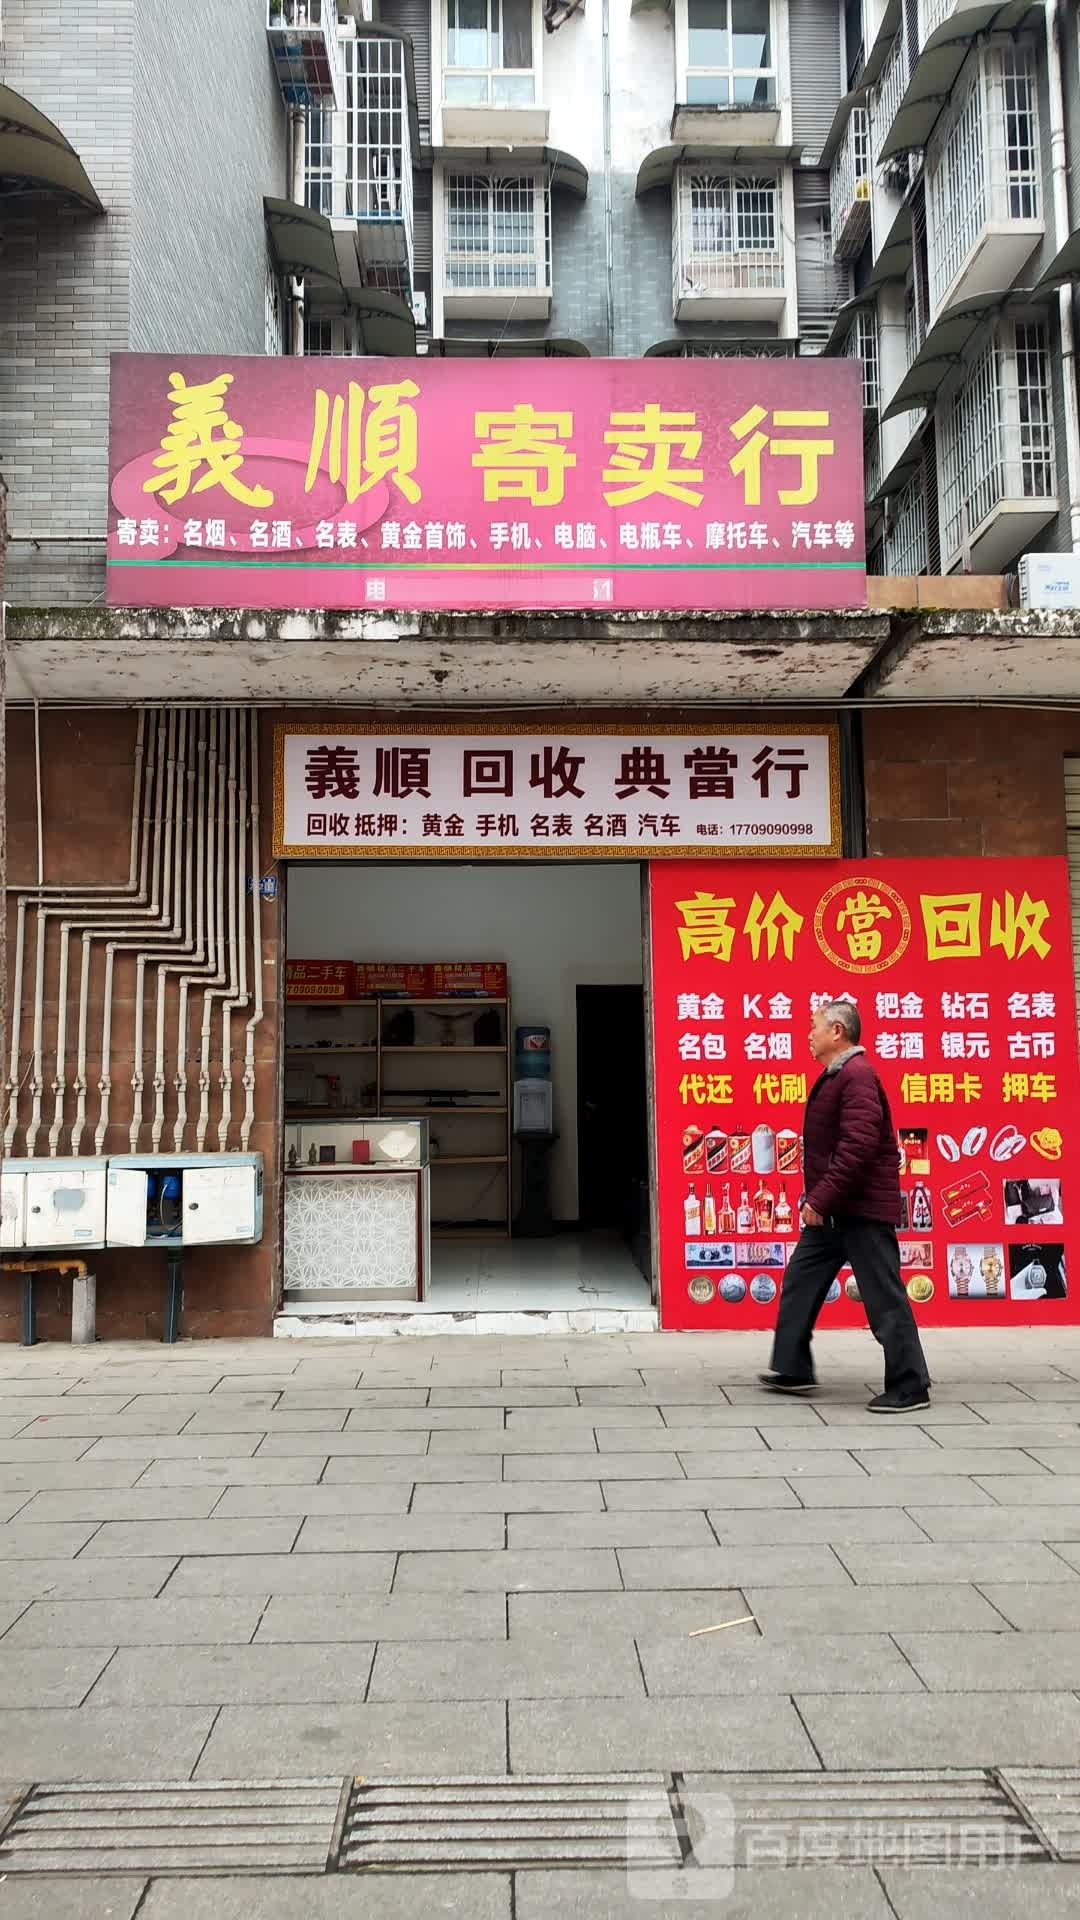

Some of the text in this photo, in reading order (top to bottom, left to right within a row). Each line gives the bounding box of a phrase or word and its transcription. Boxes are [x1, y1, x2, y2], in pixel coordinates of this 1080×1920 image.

[142, 372, 834, 507] 義順 寄卖行
[304, 745, 809, 800] 義順 回收 典當行
[421, 813, 465, 837] 黄金
[475, 813, 519, 837] 手机
[530, 812, 573, 838] 名表
[584, 812, 627, 838] 名酒
[638, 813, 681, 838] 汽车
[674, 890, 1053, 963] 高价 當 回收
[676, 992, 725, 1021] 黄金
[743, 991, 793, 1020] K金
[875, 991, 924, 1019] 钯金
[941, 991, 990, 1019] 钻石
[1007, 991, 1056, 1019] 名表
[678, 1030, 1055, 1061] 名包 名烟 老酒 银元 古币
[678, 1071, 1057, 1105] 代还 代刷 信用卡 押车
